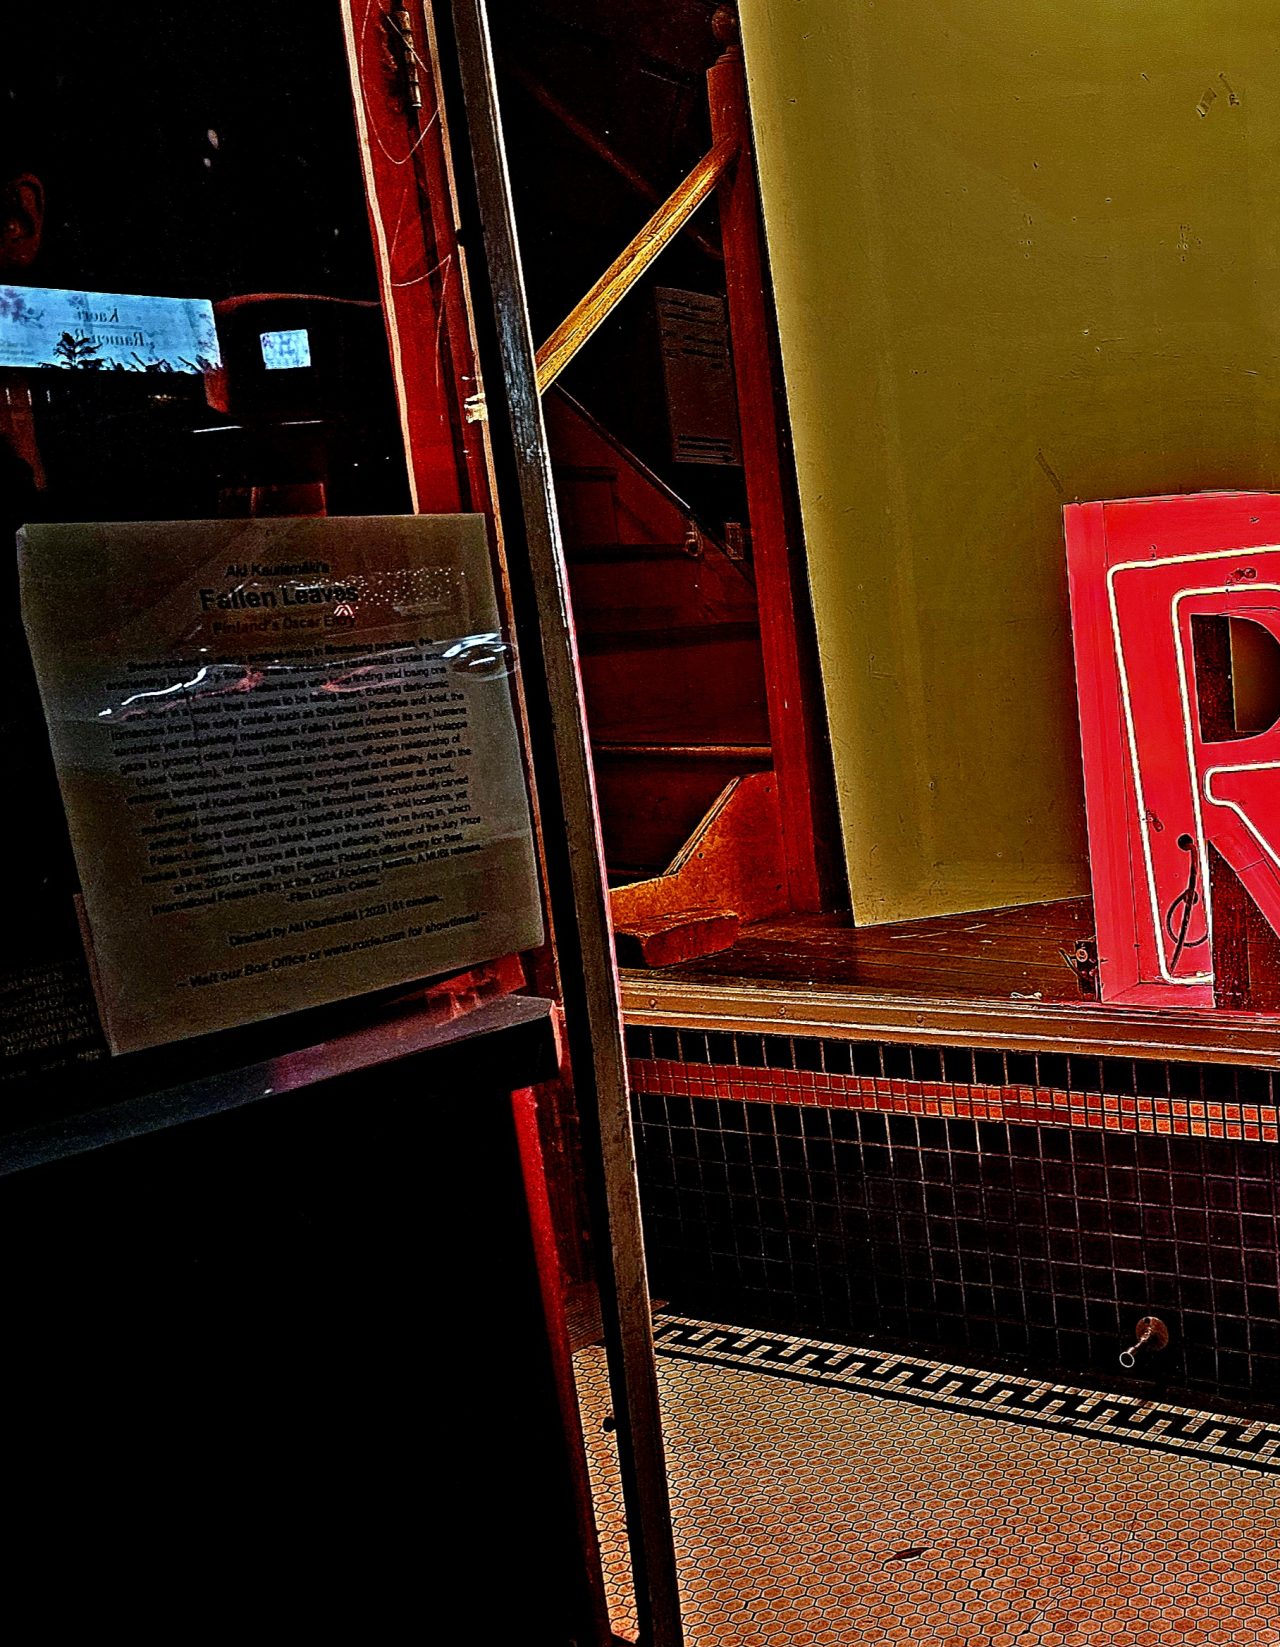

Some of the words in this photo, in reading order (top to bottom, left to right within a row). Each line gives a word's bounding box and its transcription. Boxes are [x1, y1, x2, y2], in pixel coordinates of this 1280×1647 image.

[199, 589, 276, 610] Fallen
[280, 586, 359, 604] Leaves
[352, 672, 383, 682] finding
[384, 669, 401, 678] and
[403, 668, 428, 677] losing
[220, 969, 242, 980] our
[308, 951, 321, 960] or
[407, 927, 422, 937] for
